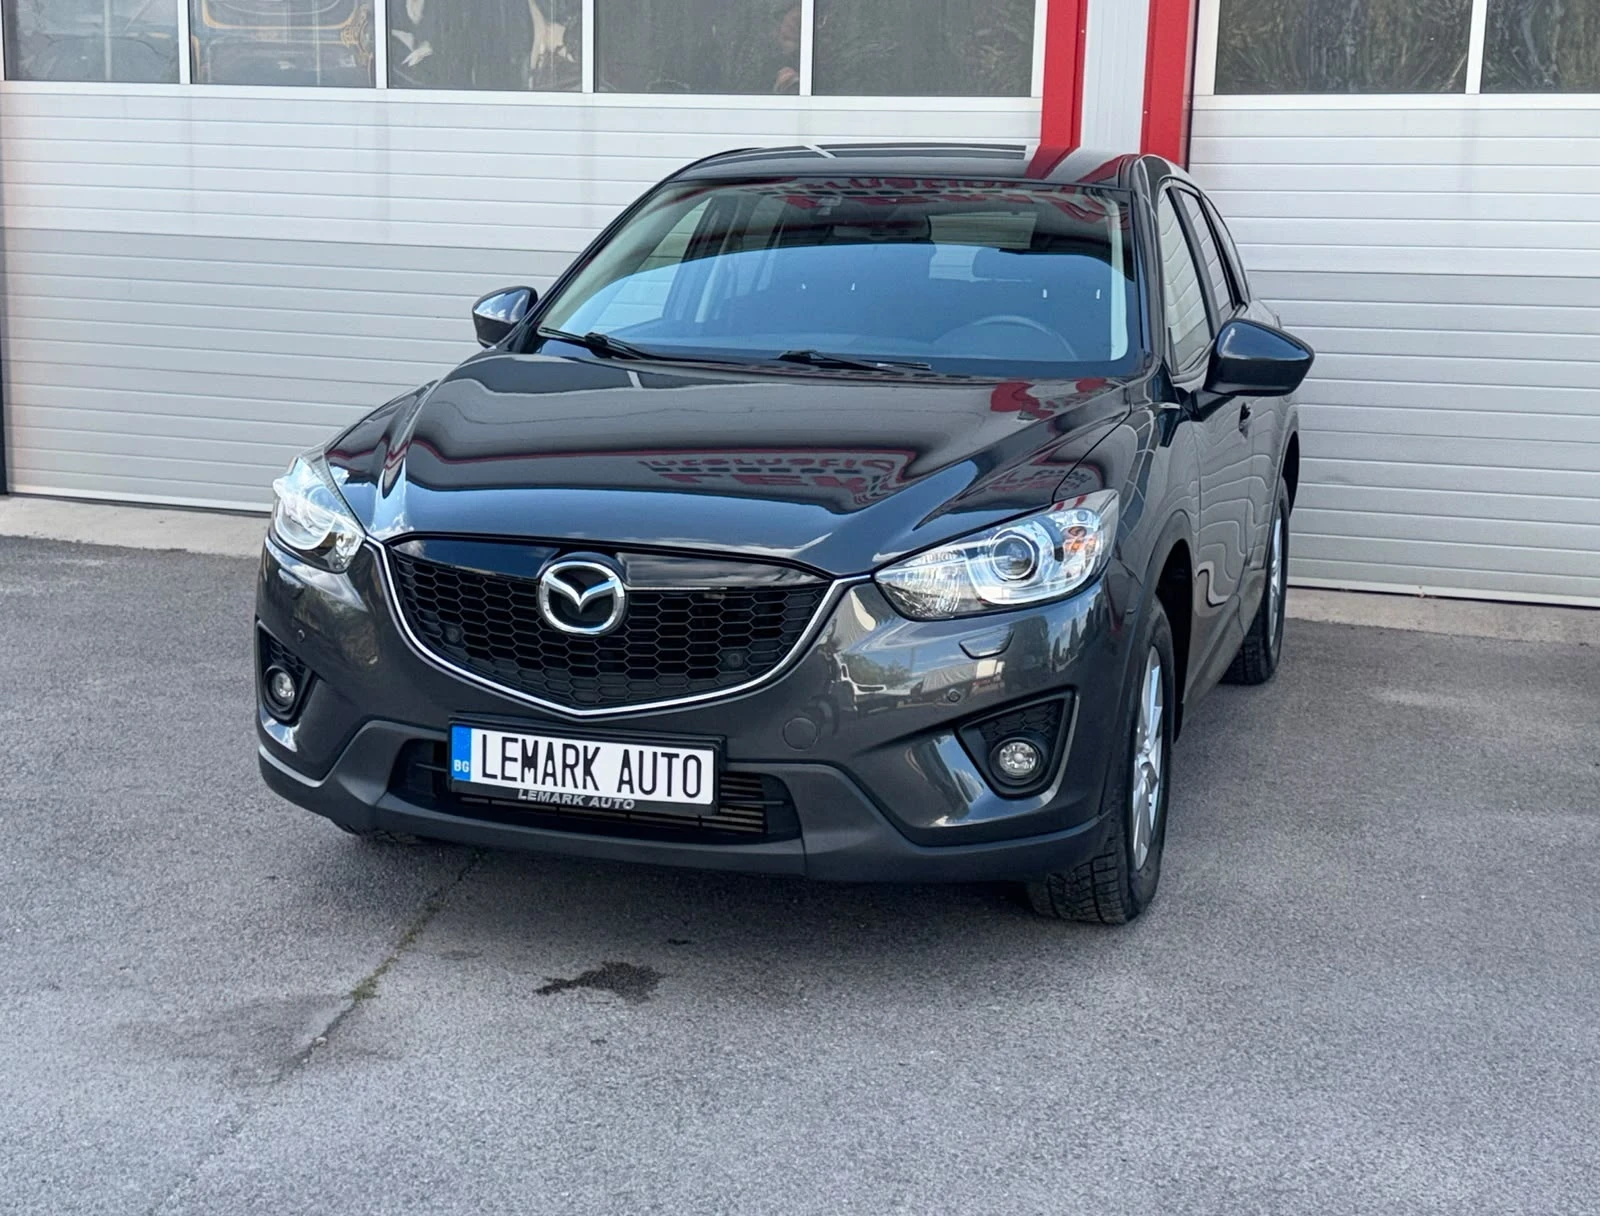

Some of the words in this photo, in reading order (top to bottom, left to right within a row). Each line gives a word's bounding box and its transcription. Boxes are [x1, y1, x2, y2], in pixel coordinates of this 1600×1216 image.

[453, 759, 470, 773] BG
[481, 734, 601, 792] LEMARK
[616, 749, 702, 799] AUTO
[518, 788, 587, 806] LEMARK
[588, 797, 635, 811] AUTO
